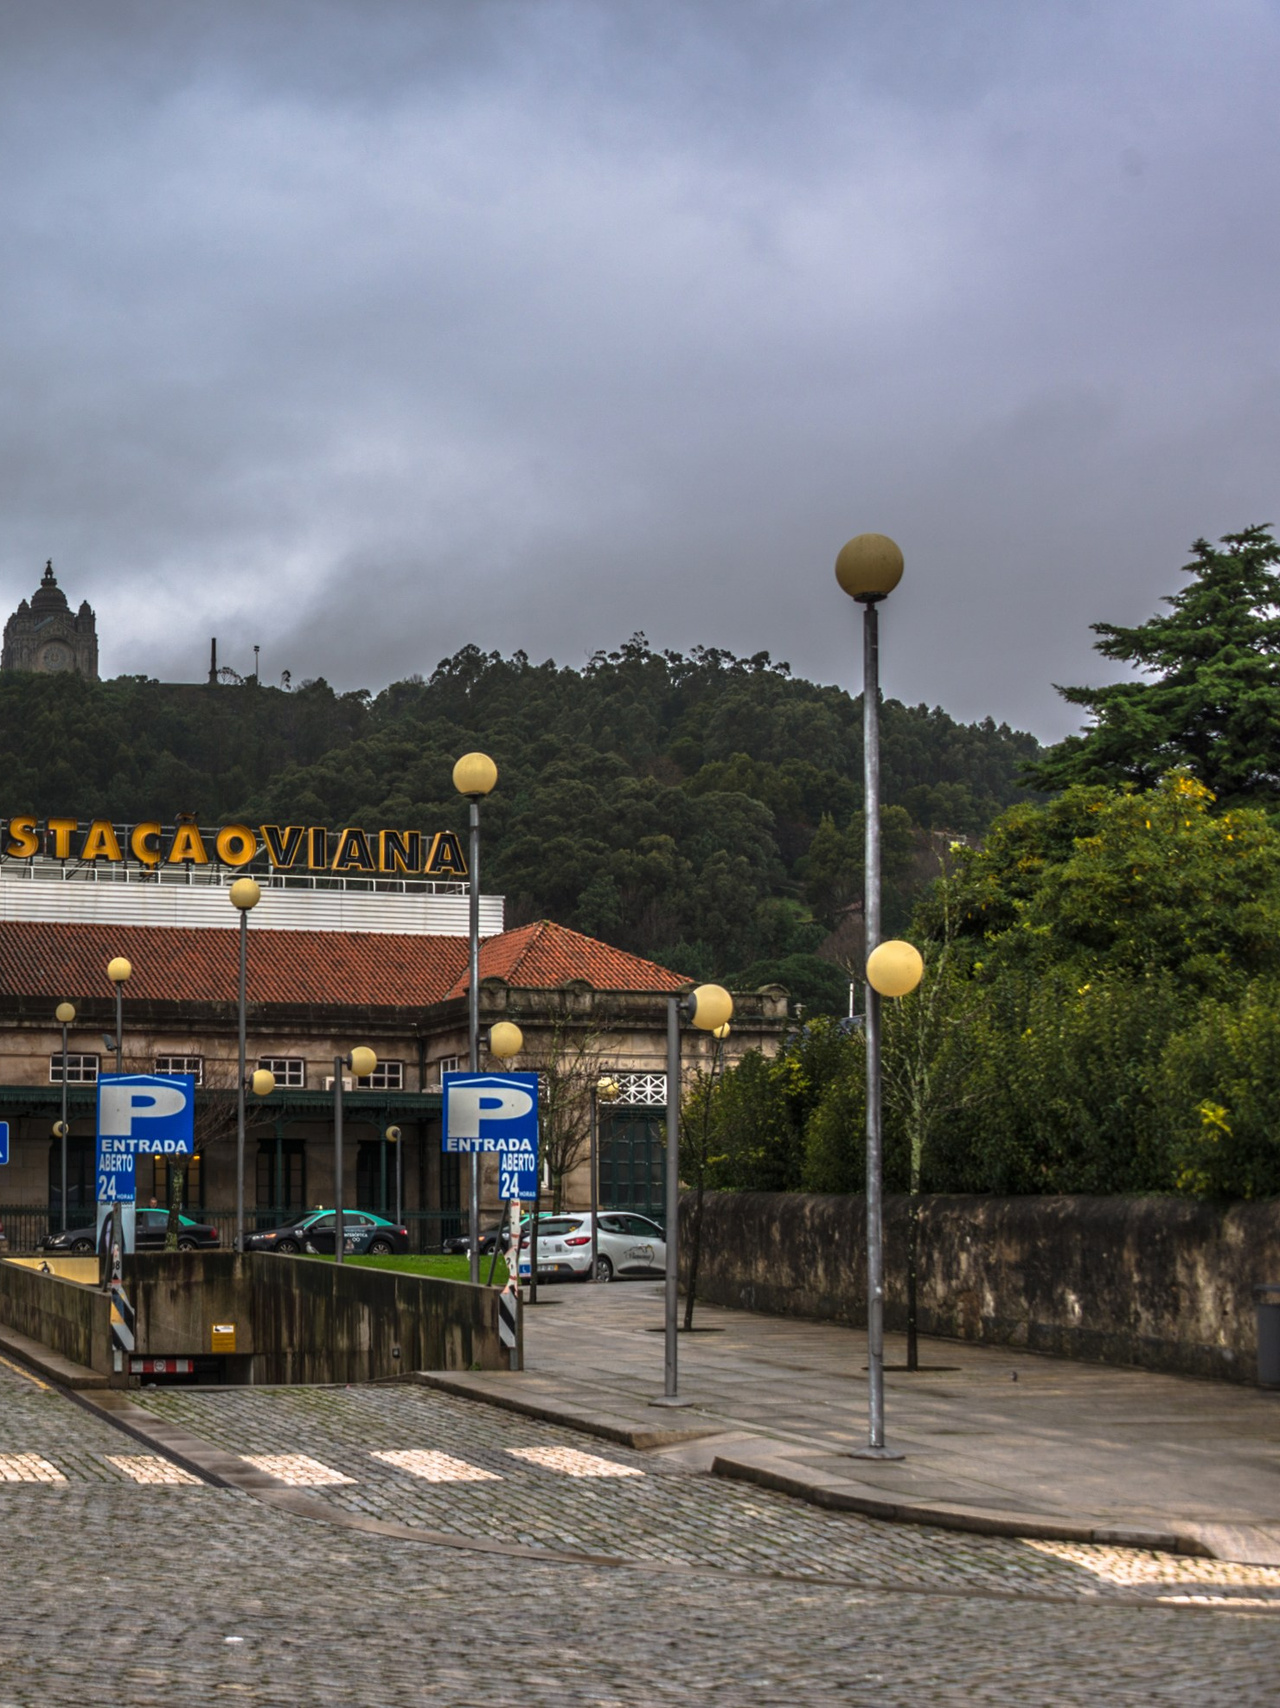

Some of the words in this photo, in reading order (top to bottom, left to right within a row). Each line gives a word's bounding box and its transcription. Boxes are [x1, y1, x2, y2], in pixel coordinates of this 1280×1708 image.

[259, 824, 468, 875] VIANA
[99, 1085, 187, 1136] P
[447, 1087, 533, 1138] P
[101, 1139, 188, 1153] ENTRADA
[447, 1138, 532, 1152] ENTRADA
[99, 1153, 133, 1172] ABERTO
[501, 1153, 535, 1172] ABERTO
[98, 1175, 117, 1200] 24
[501, 1172, 519, 1198] 24
